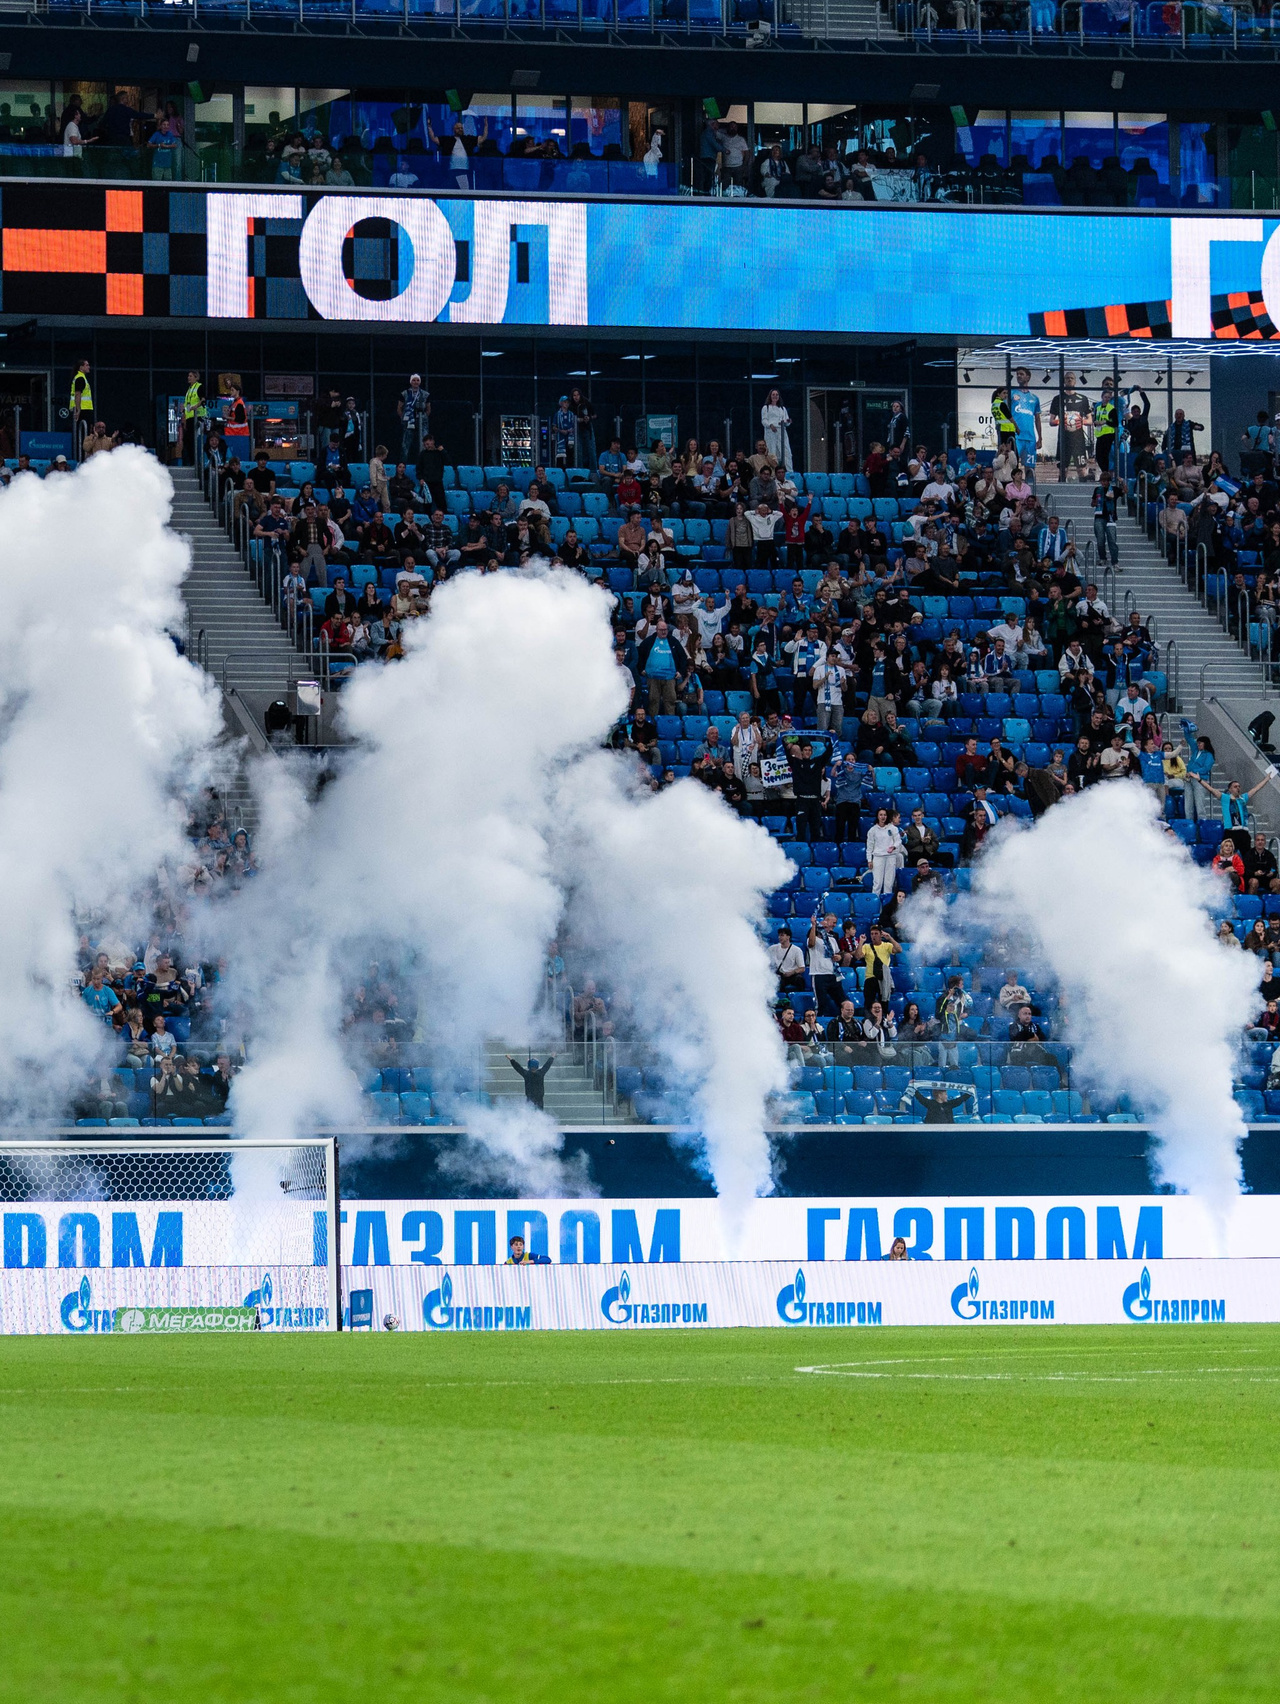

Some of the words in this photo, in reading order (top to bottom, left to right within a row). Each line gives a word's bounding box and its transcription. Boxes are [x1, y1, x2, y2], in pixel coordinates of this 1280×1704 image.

[206, 192, 589, 326] ГОЛ
[1026, 454, 1035, 464] 21
[1077, 455, 1086, 465] 16
[807, 1206, 1163, 1261] ГАЗПРОМ
[149, 1313, 255, 1328] МЕГАФОН
[455, 1306, 531, 1330] ГАЗПРОМ
[632, 1303, 708, 1323] ГАЗПРОМ
[808, 1302, 882, 1325] ГАЗПРОМ
[981, 1300, 1055, 1320] ГАЗПРОМ
[1153, 1299, 1225, 1322] ГАЗПРОМ
